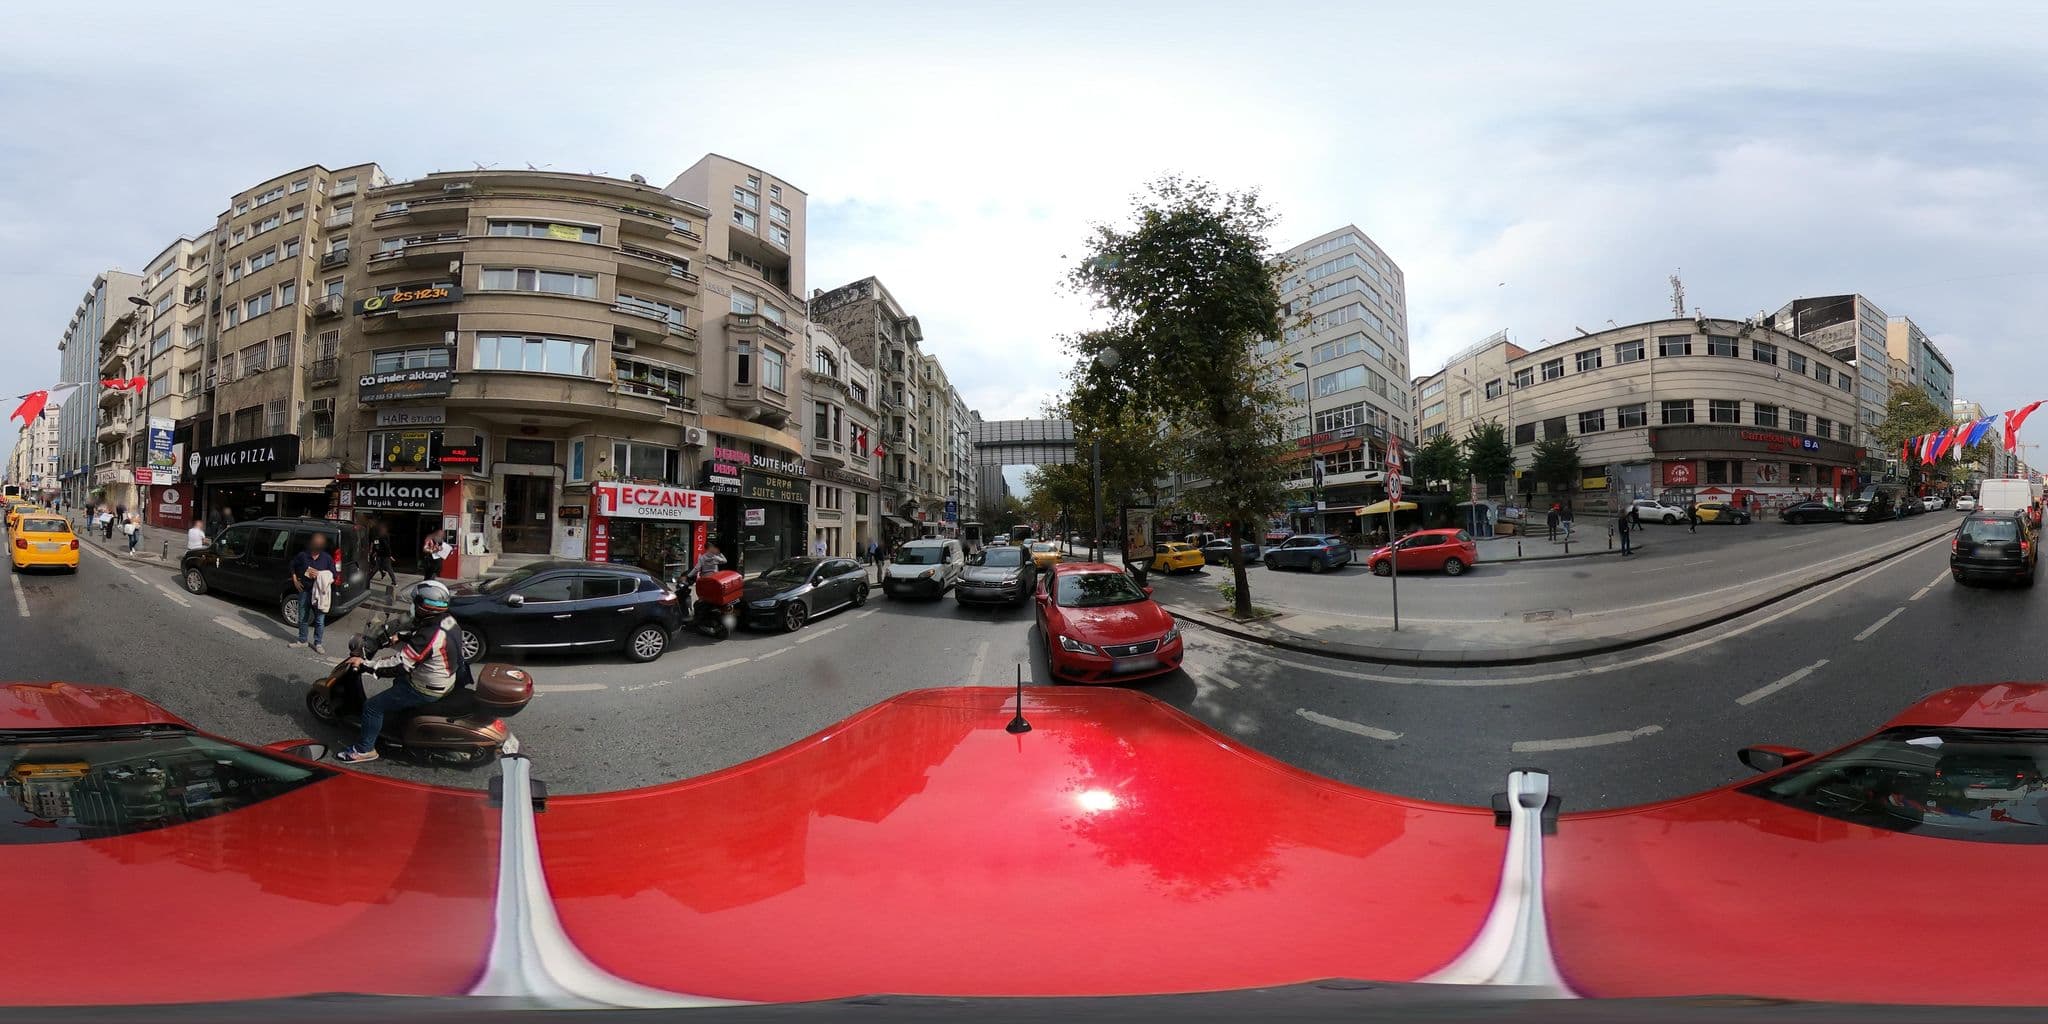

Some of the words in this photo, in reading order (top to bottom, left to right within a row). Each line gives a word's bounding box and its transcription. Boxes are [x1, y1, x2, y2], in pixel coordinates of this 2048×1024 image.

[377, 373, 406, 384] önder
[409, 370, 447, 381] akkaya
[411, 415, 442, 423] STUDIO
[204, 452, 237, 467] VIKING
[240, 447, 275, 464] PIZZA
[753, 454, 780, 470] SUITE
[781, 461, 807, 476] HOTEL
[356, 481, 440, 498] kalkancı
[766, 477, 792, 489] DERPA
[1389, 477, 1400, 495] 30
[622, 487, 697, 508] ECZANE
[752, 486, 775, 498] SUITE
[781, 490, 804, 501] HOTEL
[367, 499, 392, 508] Büyük
[397, 500, 425, 508] Beden
[638, 507, 682, 517] OSMANBEY
